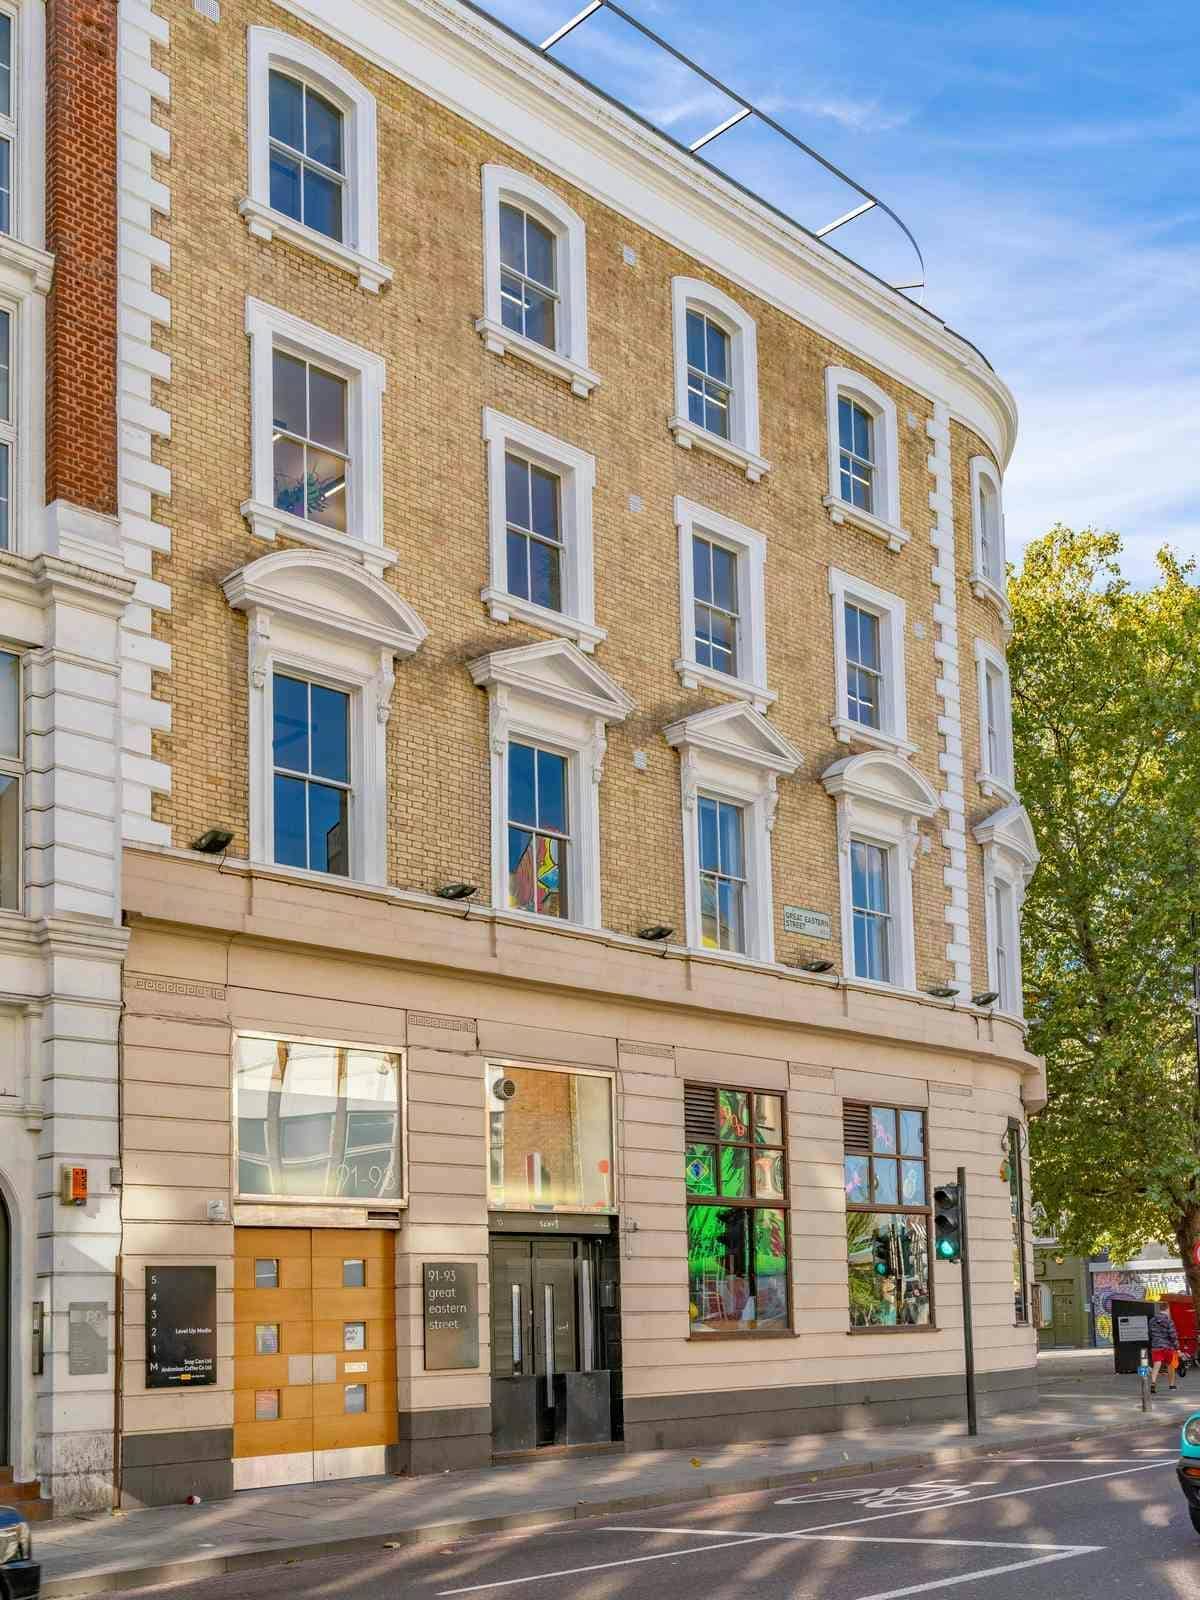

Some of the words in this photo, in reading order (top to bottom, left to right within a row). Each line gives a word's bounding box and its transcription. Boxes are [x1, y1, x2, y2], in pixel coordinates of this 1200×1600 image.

[785, 911, 803, 921] GREAT
[804, 915, 830, 929] EASTERN
[785, 919, 806, 930] STREET
[151, 1275, 158, 1285] 5
[151, 1292, 158, 1302] 4
[428, 1287, 457, 1301] great
[151, 1309, 158, 1320] 3
[428, 1303, 468, 1315] eastern
[428, 1319, 459, 1330] street
[151, 1327, 158, 1337] 2
[153, 1344, 157, 1354] 1
[150, 1361, 159, 1372] M
